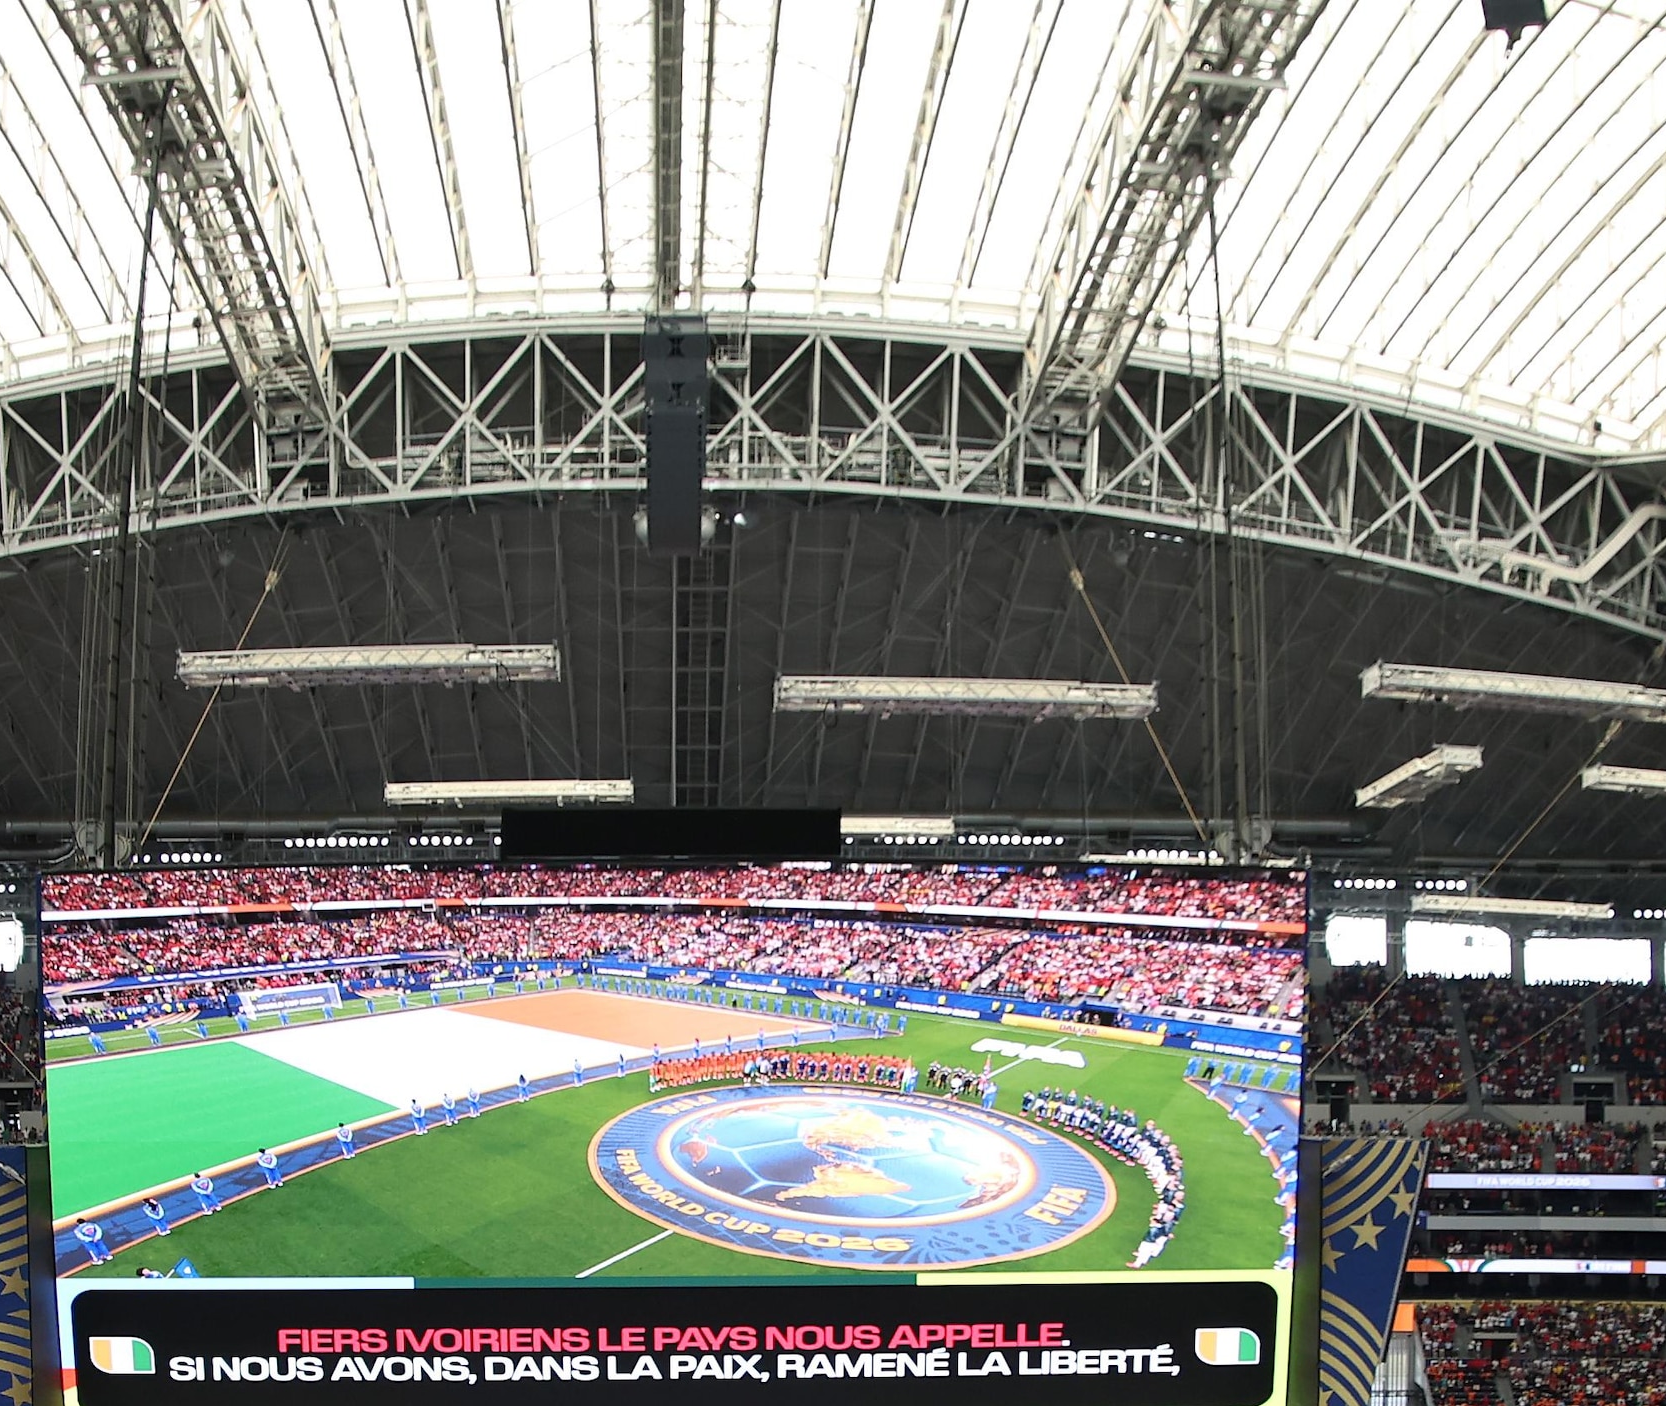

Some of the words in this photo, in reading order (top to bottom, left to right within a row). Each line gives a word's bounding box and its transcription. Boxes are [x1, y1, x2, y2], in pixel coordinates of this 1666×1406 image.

[614, 1148, 640, 1178] FIFA
[634, 1172, 704, 1218] WORLD
[708, 1211, 771, 1238] CUP
[772, 1227, 912, 1253] 2026
[1477, 1177, 1498, 1186] FIFA
[1500, 1177, 1532, 1187] WORLD
[1533, 1178, 1554, 1187] CUP
[1555, 1177, 1591, 1187] 2026
[1023, 1187, 1087, 1226] FIFA
[277, 1327, 389, 1354] FIERS
[394, 1326, 591, 1354] IVOIRIENS
[597, 1326, 646, 1352] LE
[652, 1325, 758, 1352] PAYS
[764, 1323, 882, 1351] NOUS
[886, 1321, 1070, 1349] APPELLE.
[168, 1356, 205, 1381] SI
[212, 1355, 324, 1381] NOUS
[328, 1355, 478, 1385] AVONS,
[483, 1354, 600, 1381] DANS
[604, 1354, 665, 1380] LA
[671, 1353, 773, 1384] PAIX,
[777, 1348, 951, 1379] RAMENÉ
[955, 1351, 1011, 1377] LA
[1015, 1345, 1181, 1379] LIBERTÉ,
